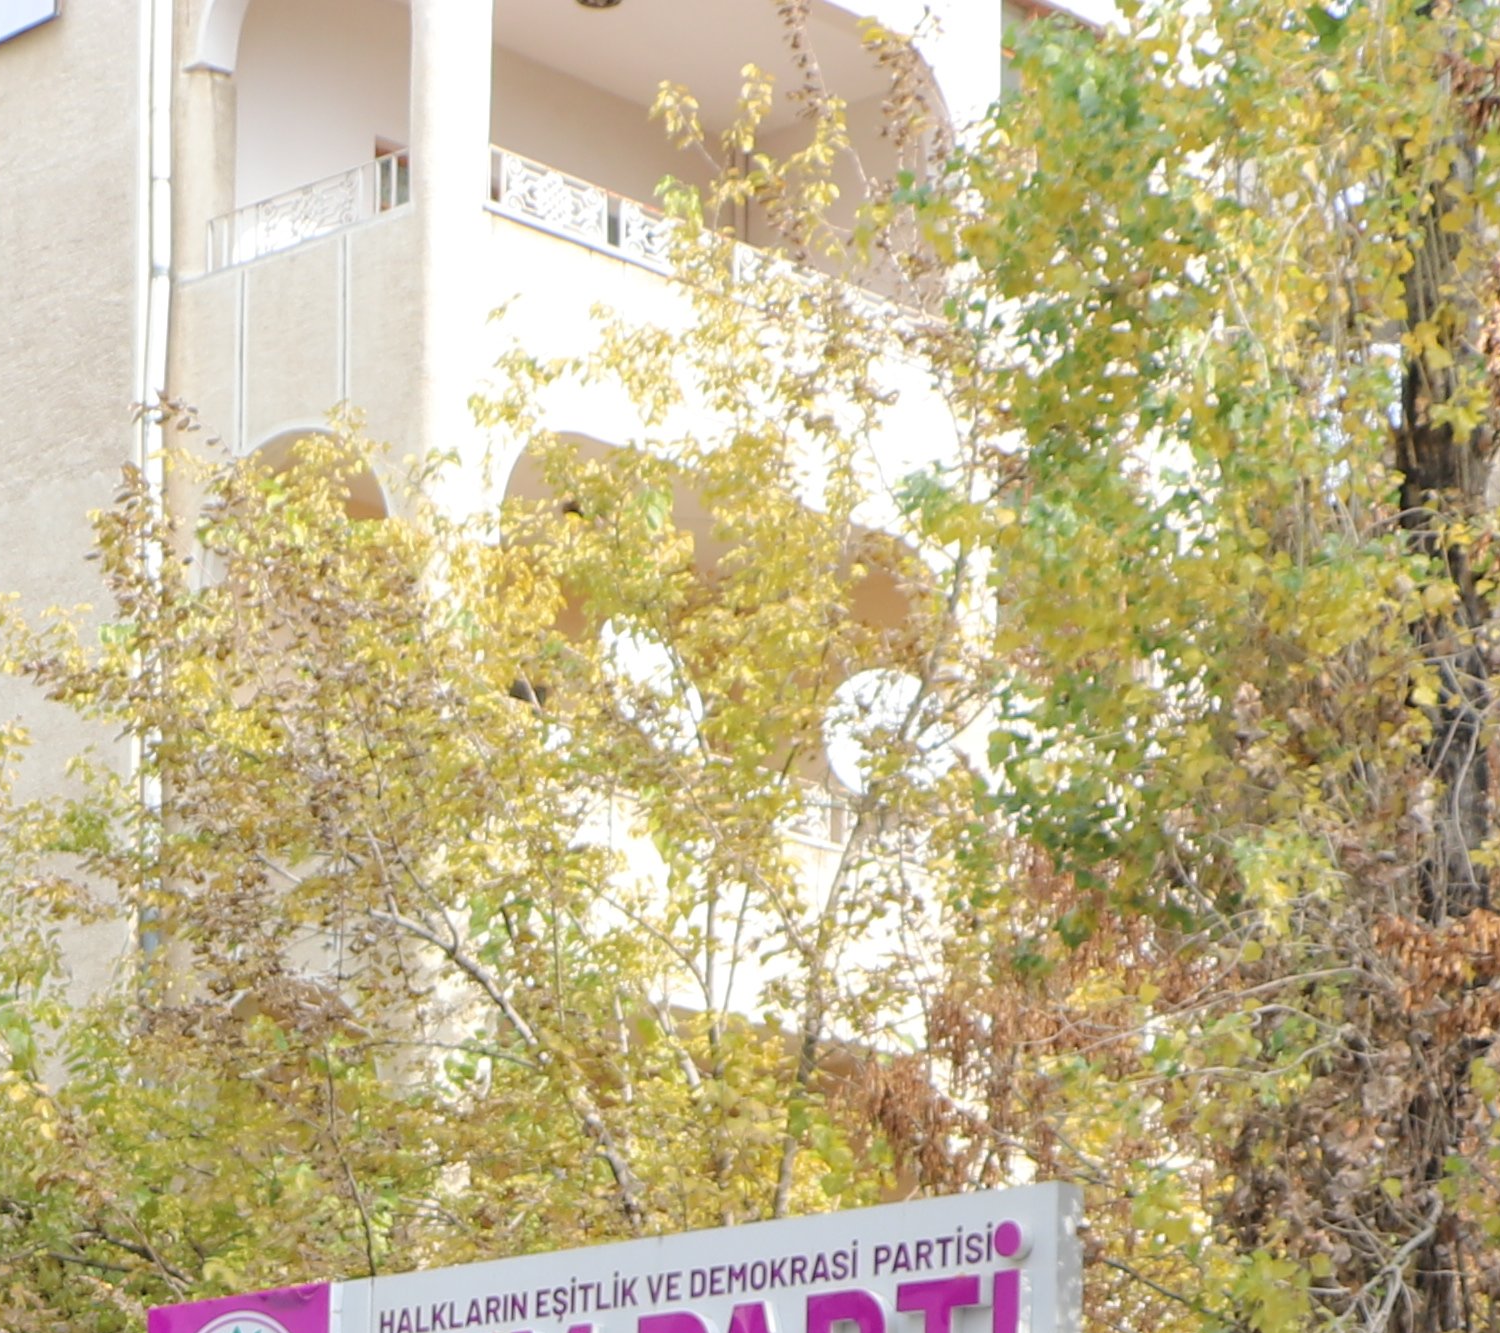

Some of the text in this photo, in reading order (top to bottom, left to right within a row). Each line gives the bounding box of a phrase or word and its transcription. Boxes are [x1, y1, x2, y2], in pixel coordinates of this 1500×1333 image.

[535, 1271, 639, 1323] EŞİTLİK
[647, 1269, 683, 1304] VE
[689, 1240, 859, 1299] DEMOKRASİ
[873, 1222, 994, 1276] PARTİSİ
